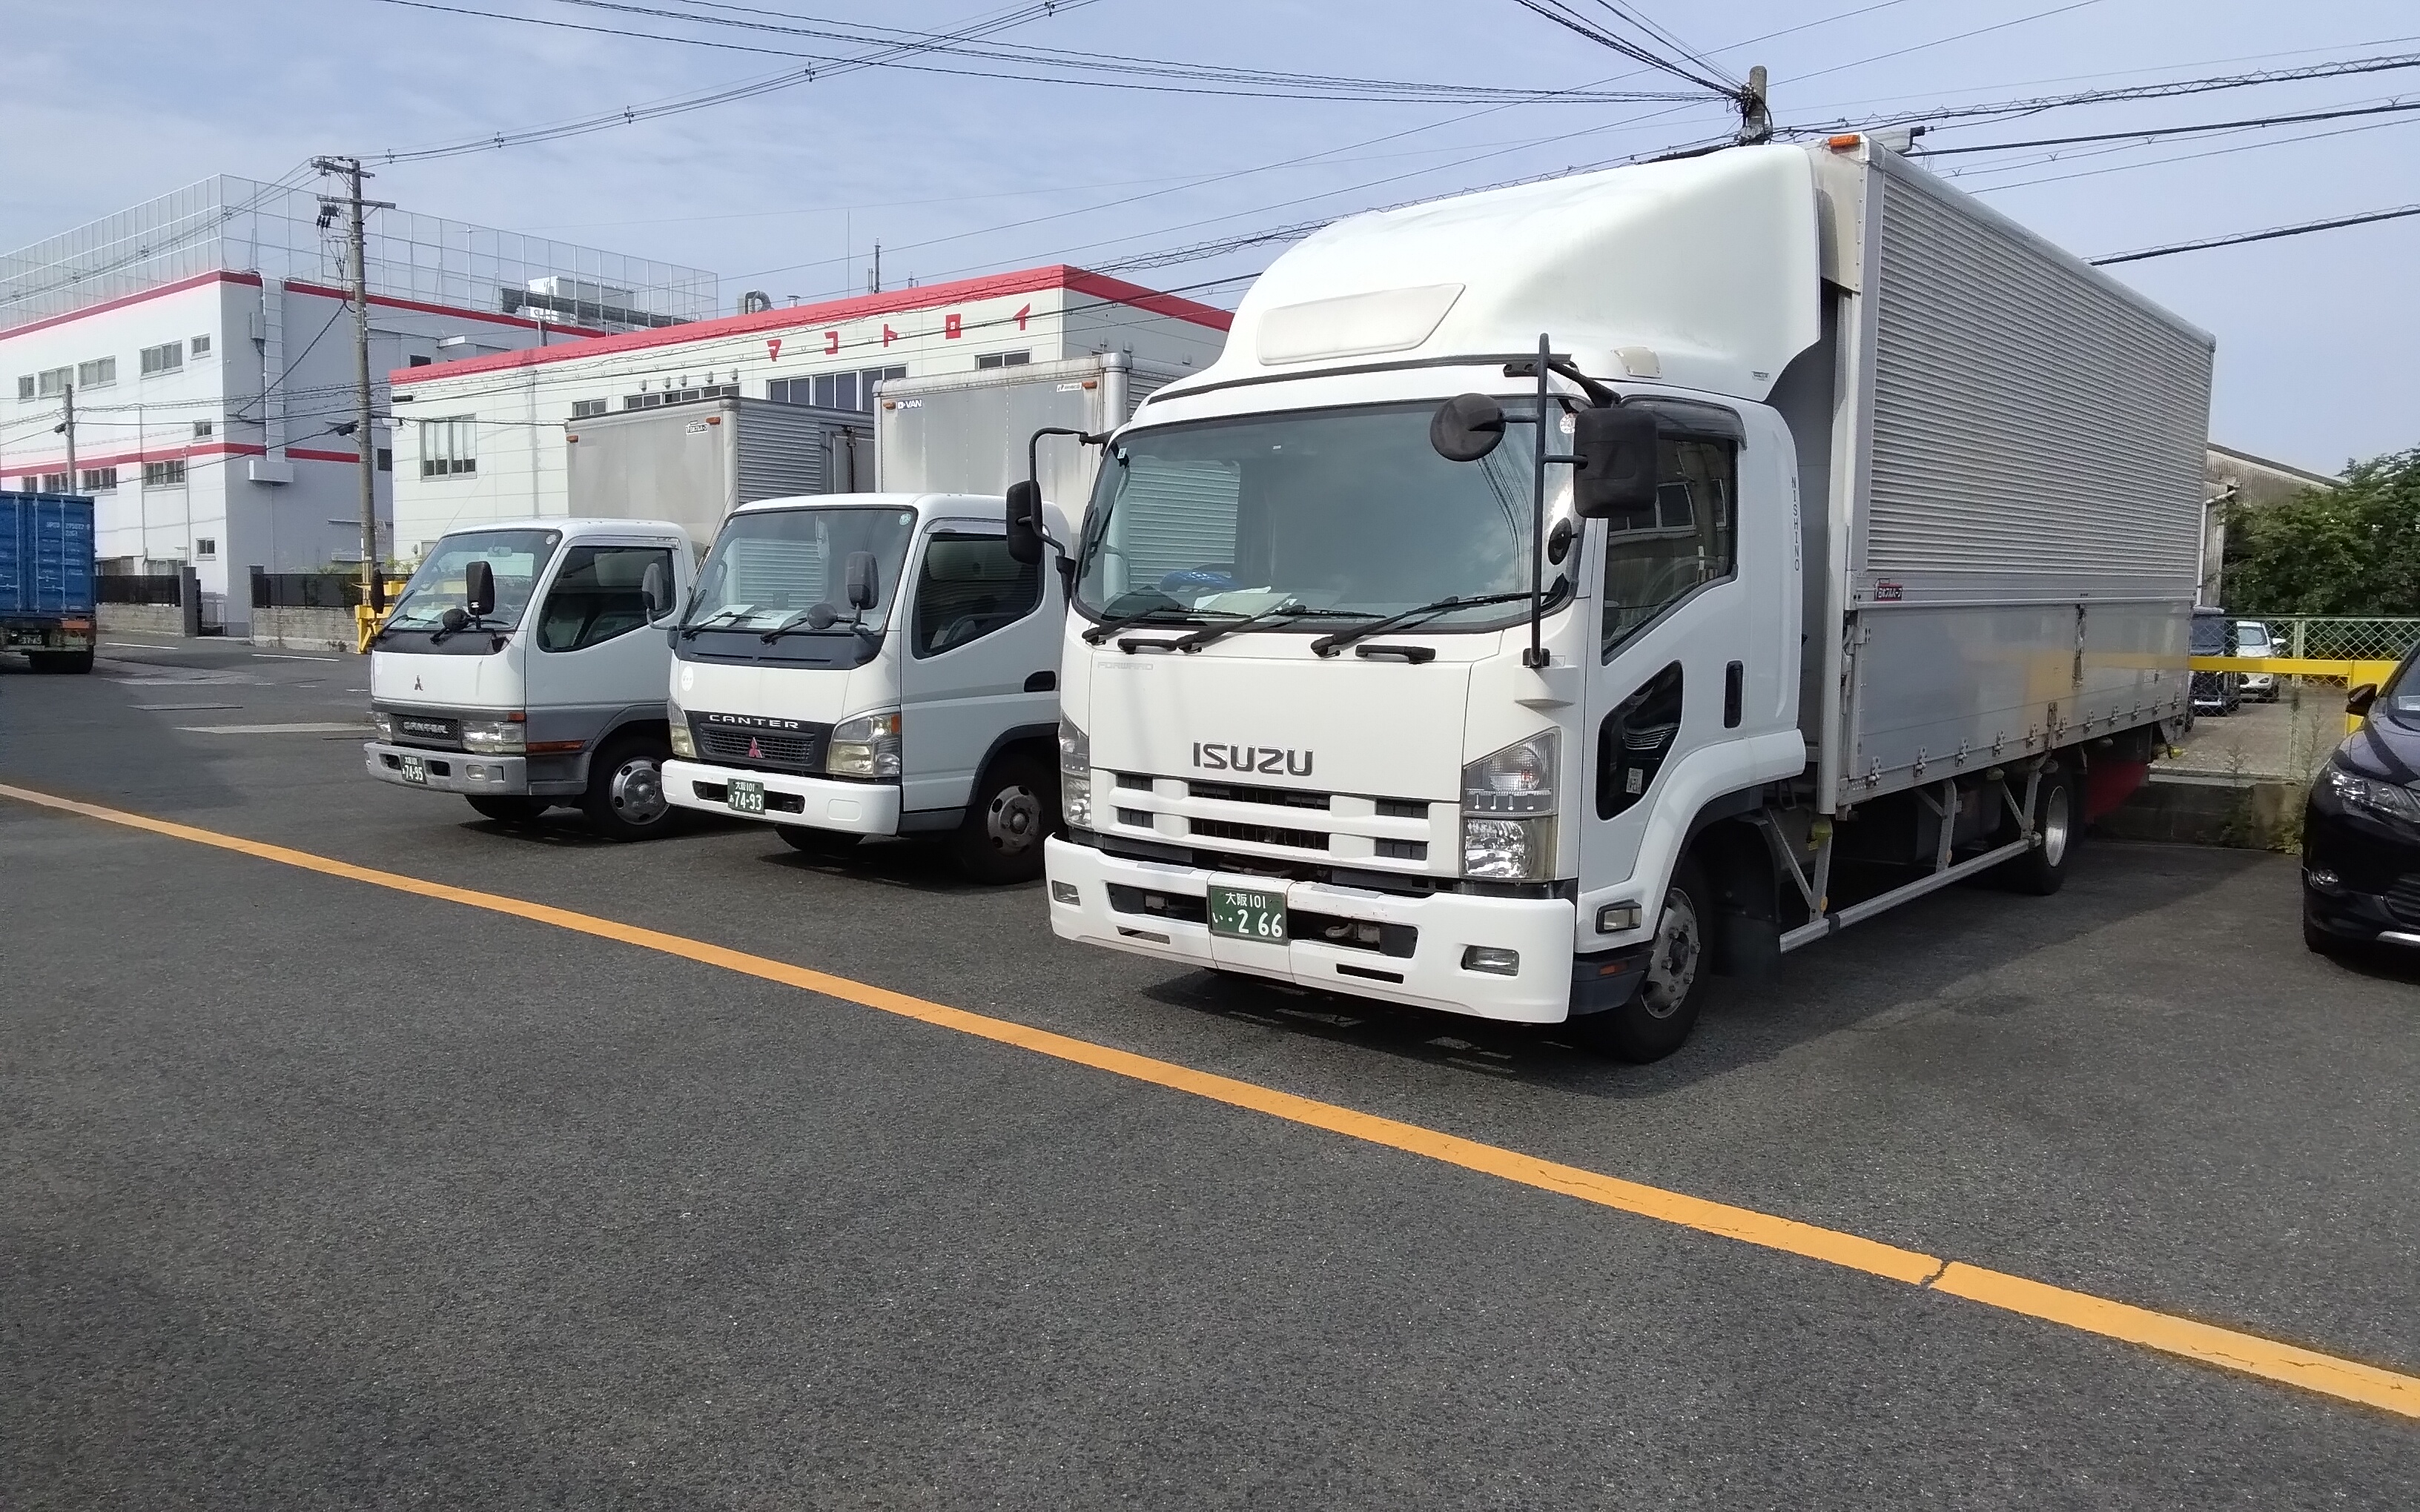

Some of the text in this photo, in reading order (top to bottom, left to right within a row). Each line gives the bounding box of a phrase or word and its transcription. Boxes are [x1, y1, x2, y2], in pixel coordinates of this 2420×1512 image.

[767, 302, 1031, 362] マコトロイ
[1791, 476, 1800, 571] NISHINO
[1097, 661, 1154, 670] FORWARD
[709, 714, 799, 729] CANTER
[1193, 740, 1314, 776] ISUZU
